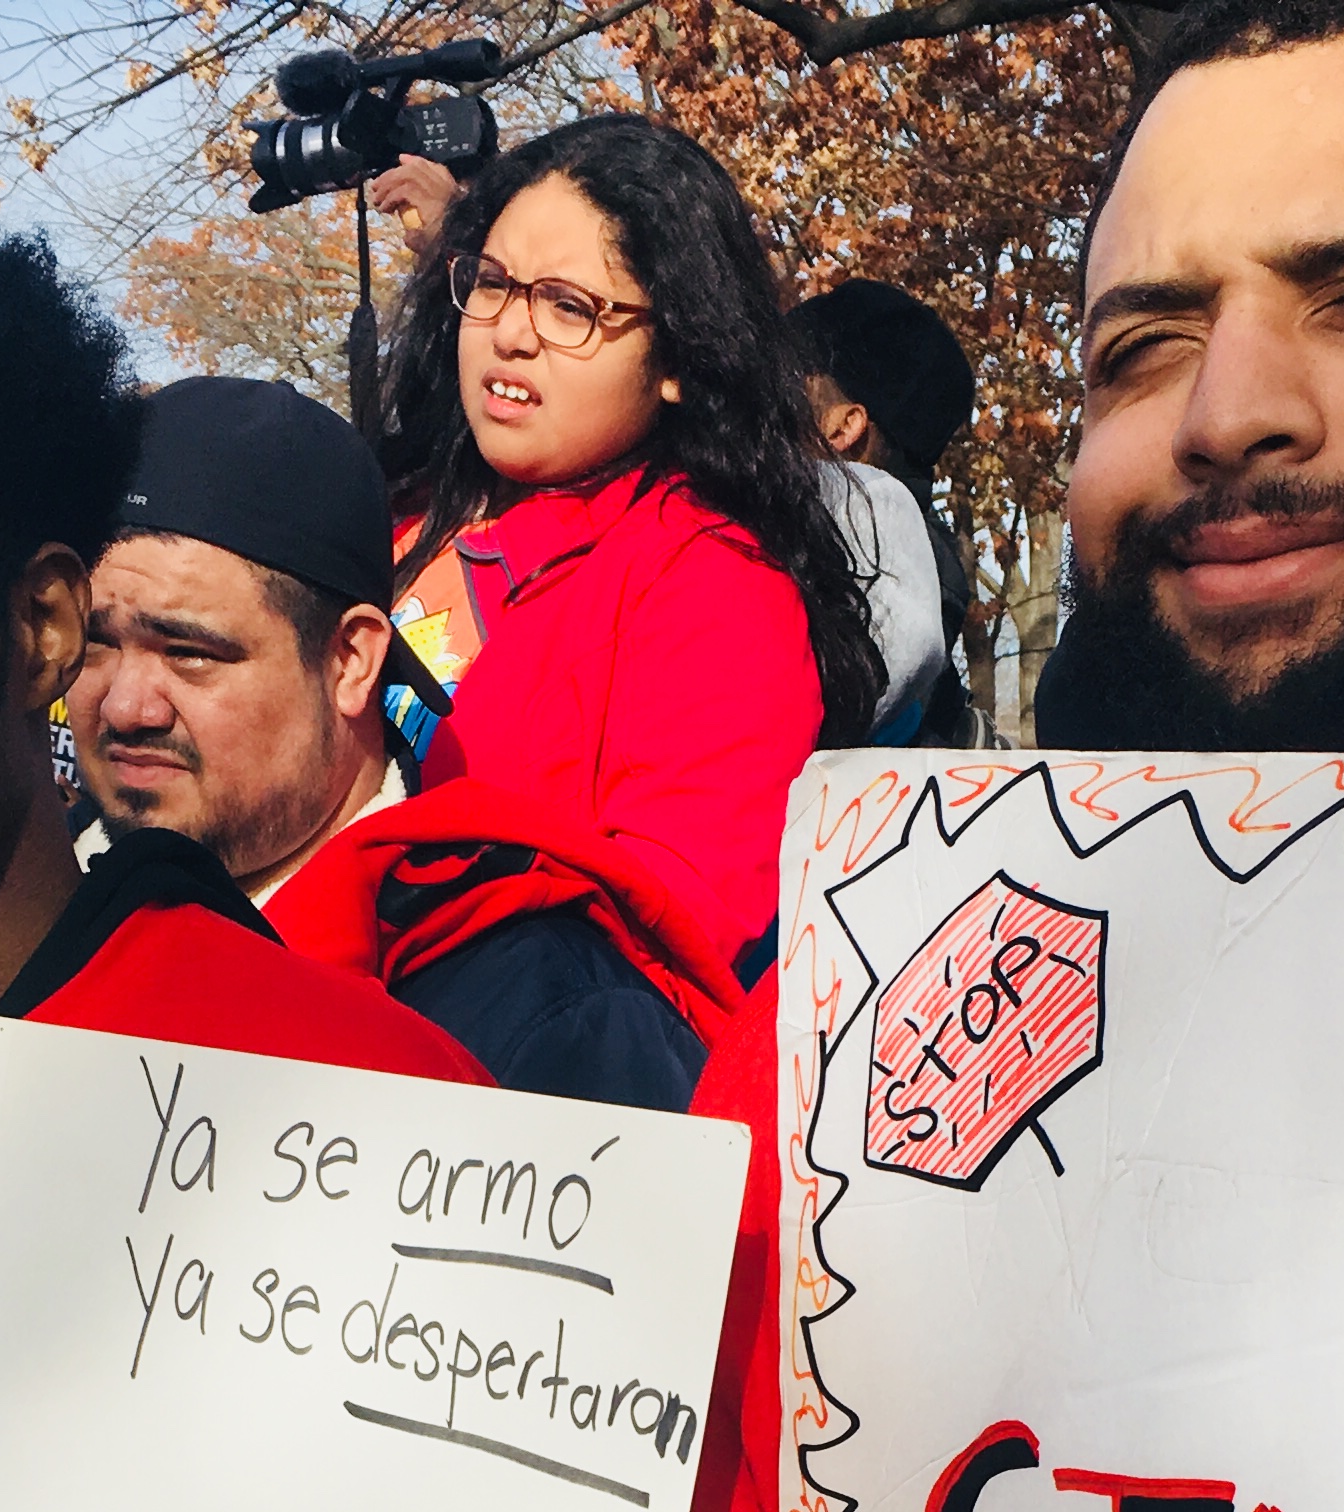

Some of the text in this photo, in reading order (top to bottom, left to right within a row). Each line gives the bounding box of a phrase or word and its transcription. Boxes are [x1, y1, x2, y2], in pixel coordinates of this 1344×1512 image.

[884, 935, 1042, 1142] STOP
[139, 1055, 621, 1250] Ya se armó
[239, 1267, 321, 1355] se
[341, 1262, 698, 1465] despertaron
